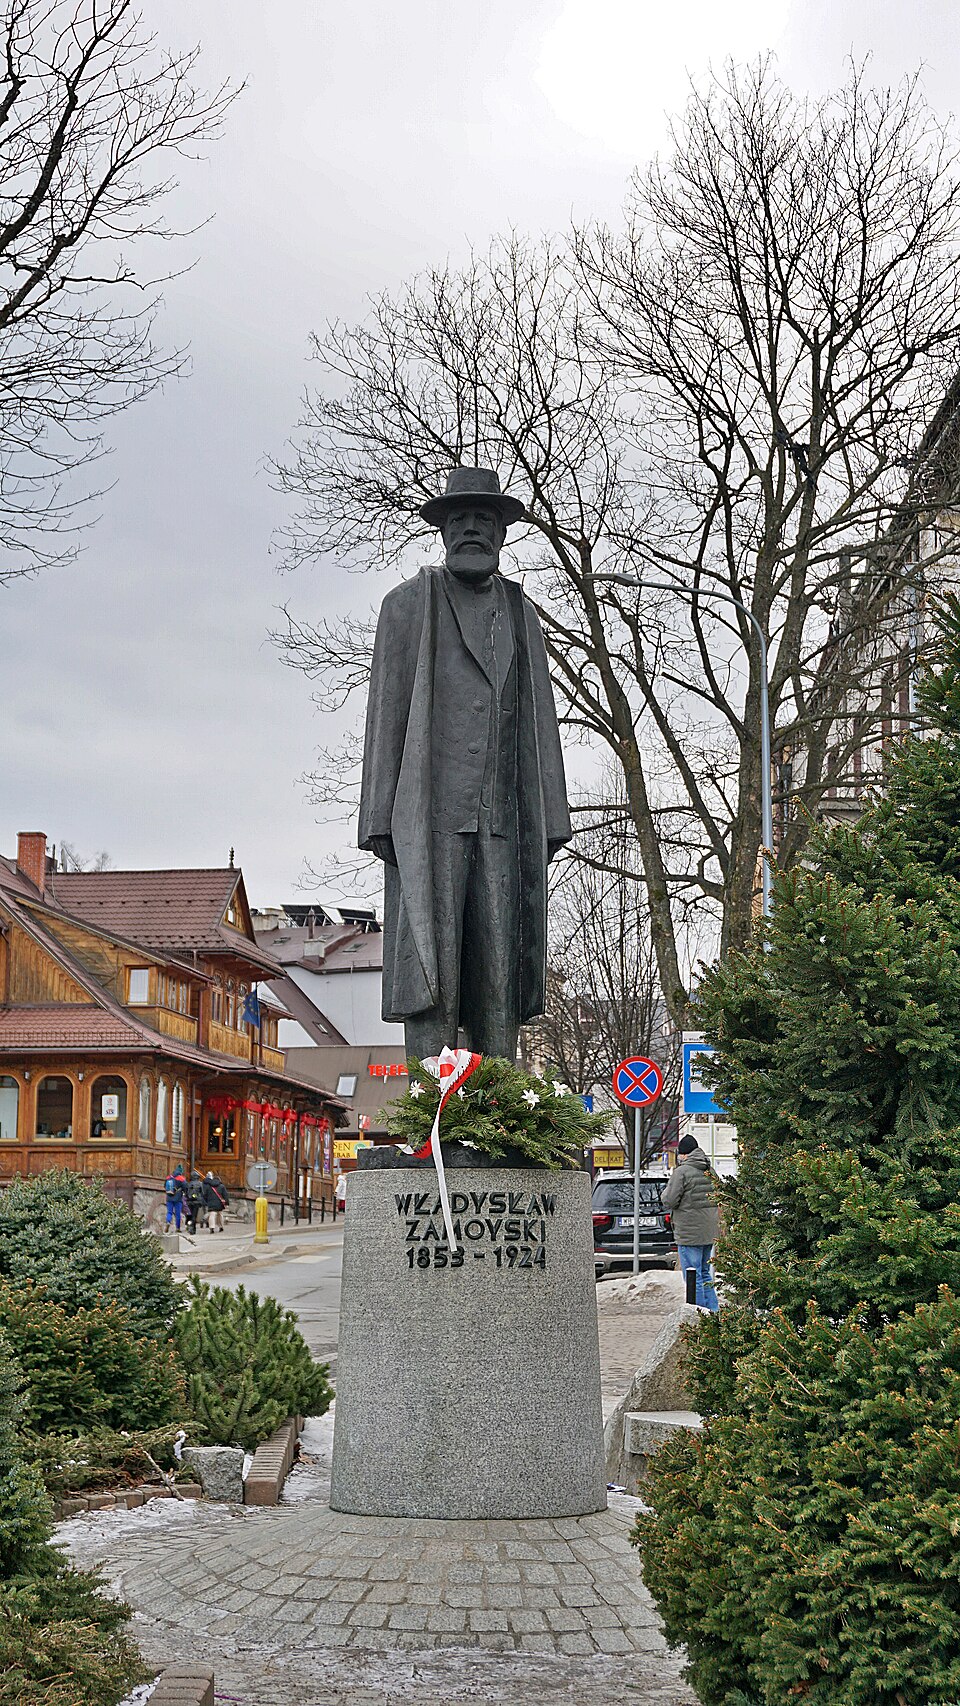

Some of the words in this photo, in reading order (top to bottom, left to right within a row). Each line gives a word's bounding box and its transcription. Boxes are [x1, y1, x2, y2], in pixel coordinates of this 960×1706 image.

[405, 1218, 546, 1242] ZAMOYSKI
[405, 1245, 465, 1269] 1853
[493, 1245, 546, 1269] 1924
